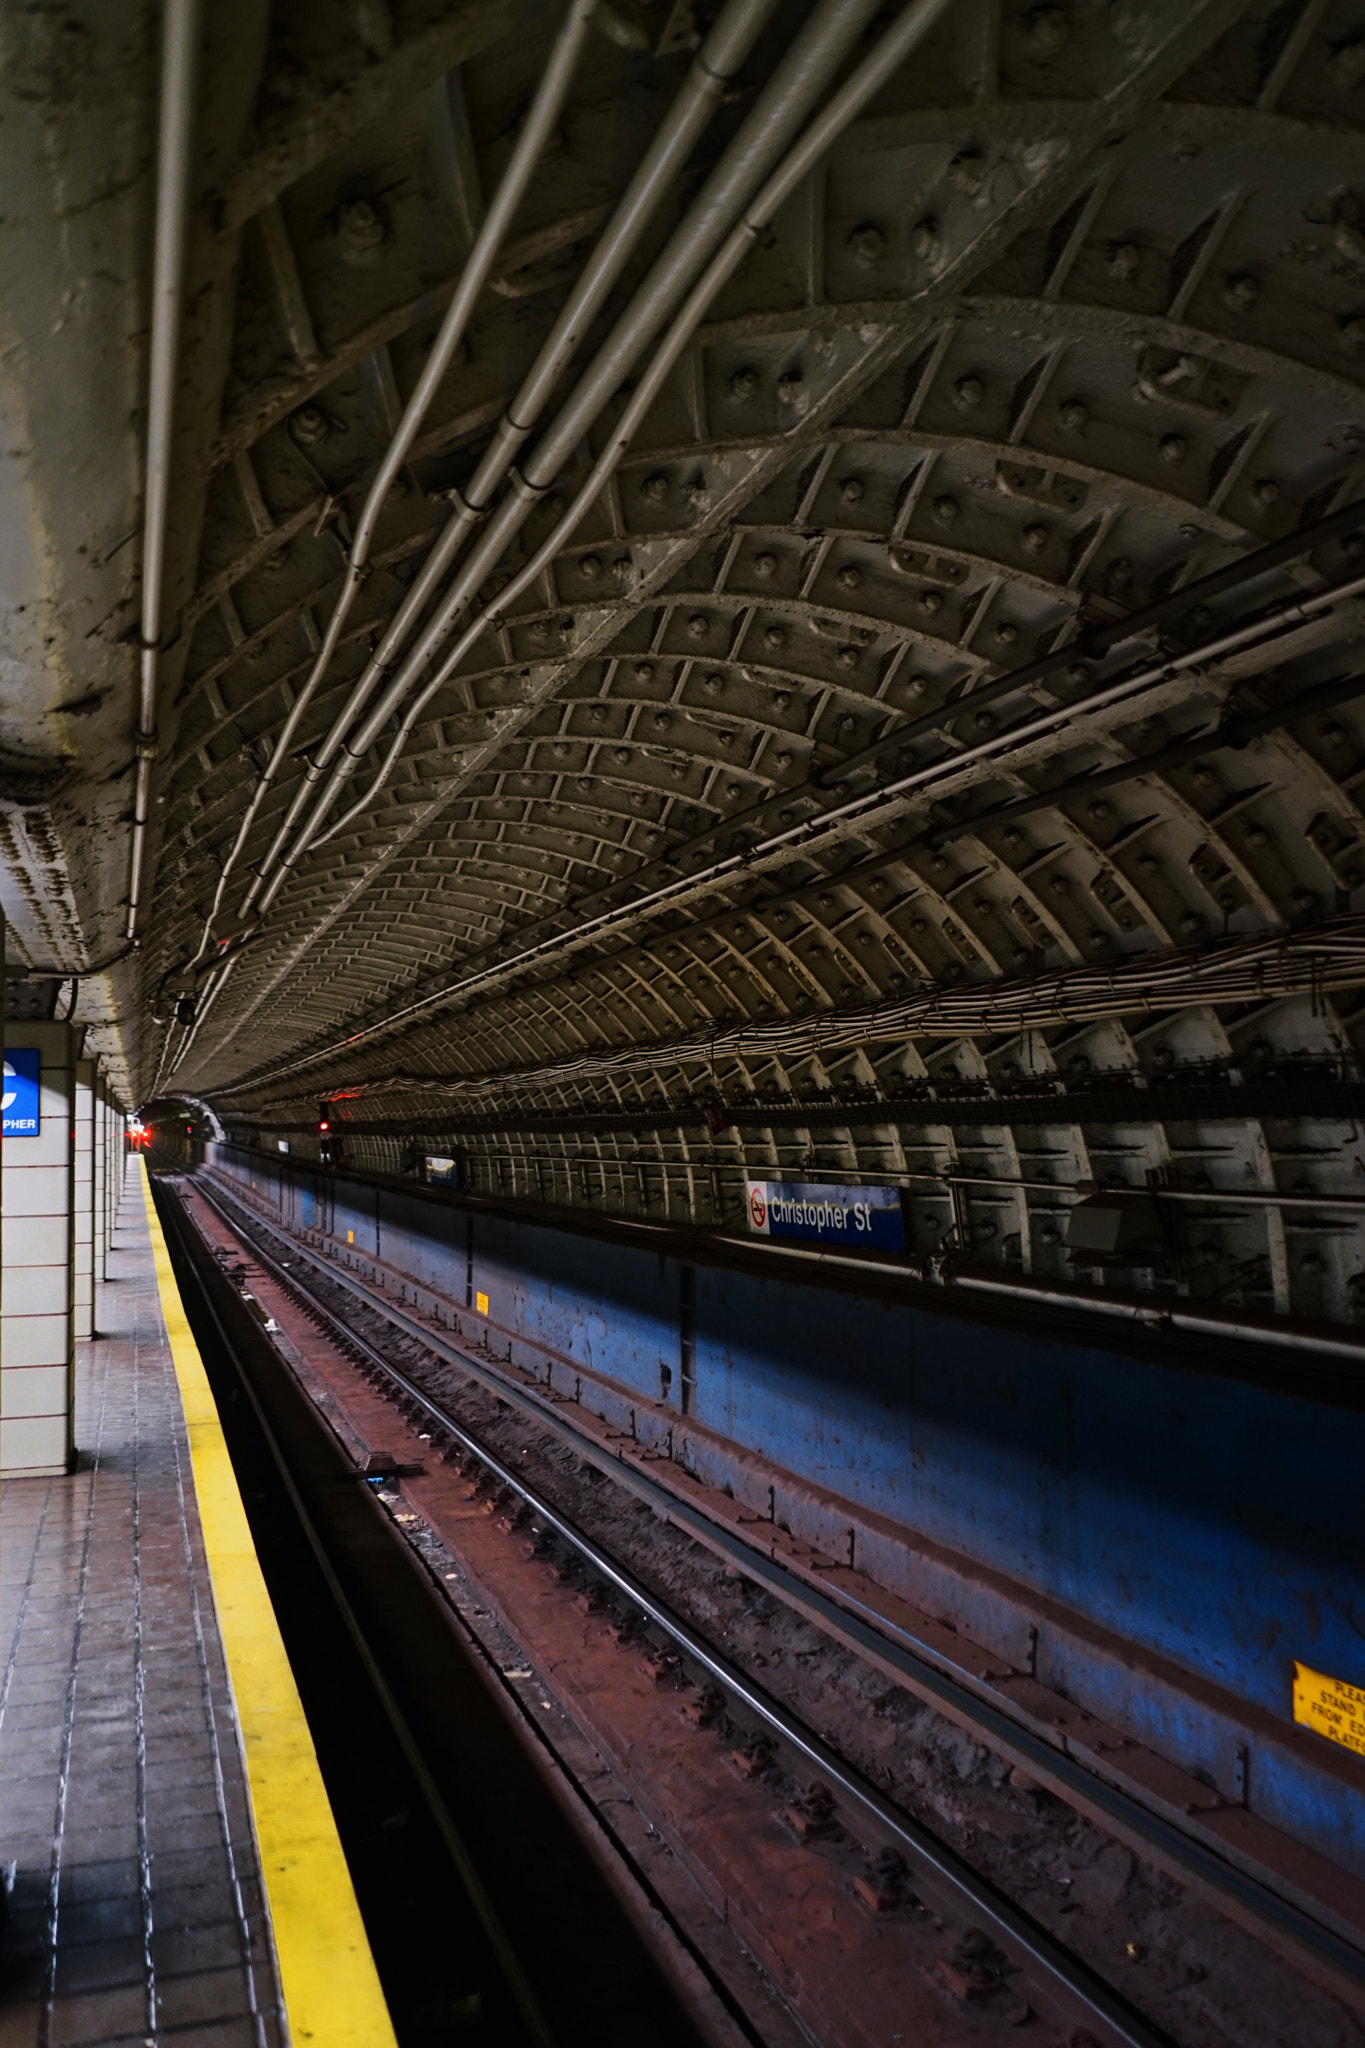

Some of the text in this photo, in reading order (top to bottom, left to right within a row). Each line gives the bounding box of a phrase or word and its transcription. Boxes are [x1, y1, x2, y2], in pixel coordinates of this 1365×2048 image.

[771, 1196, 872, 1233] Christopher St
[1311, 1701, 1342, 1726] FROM
[1320, 1690, 1356, 1717] STAND
